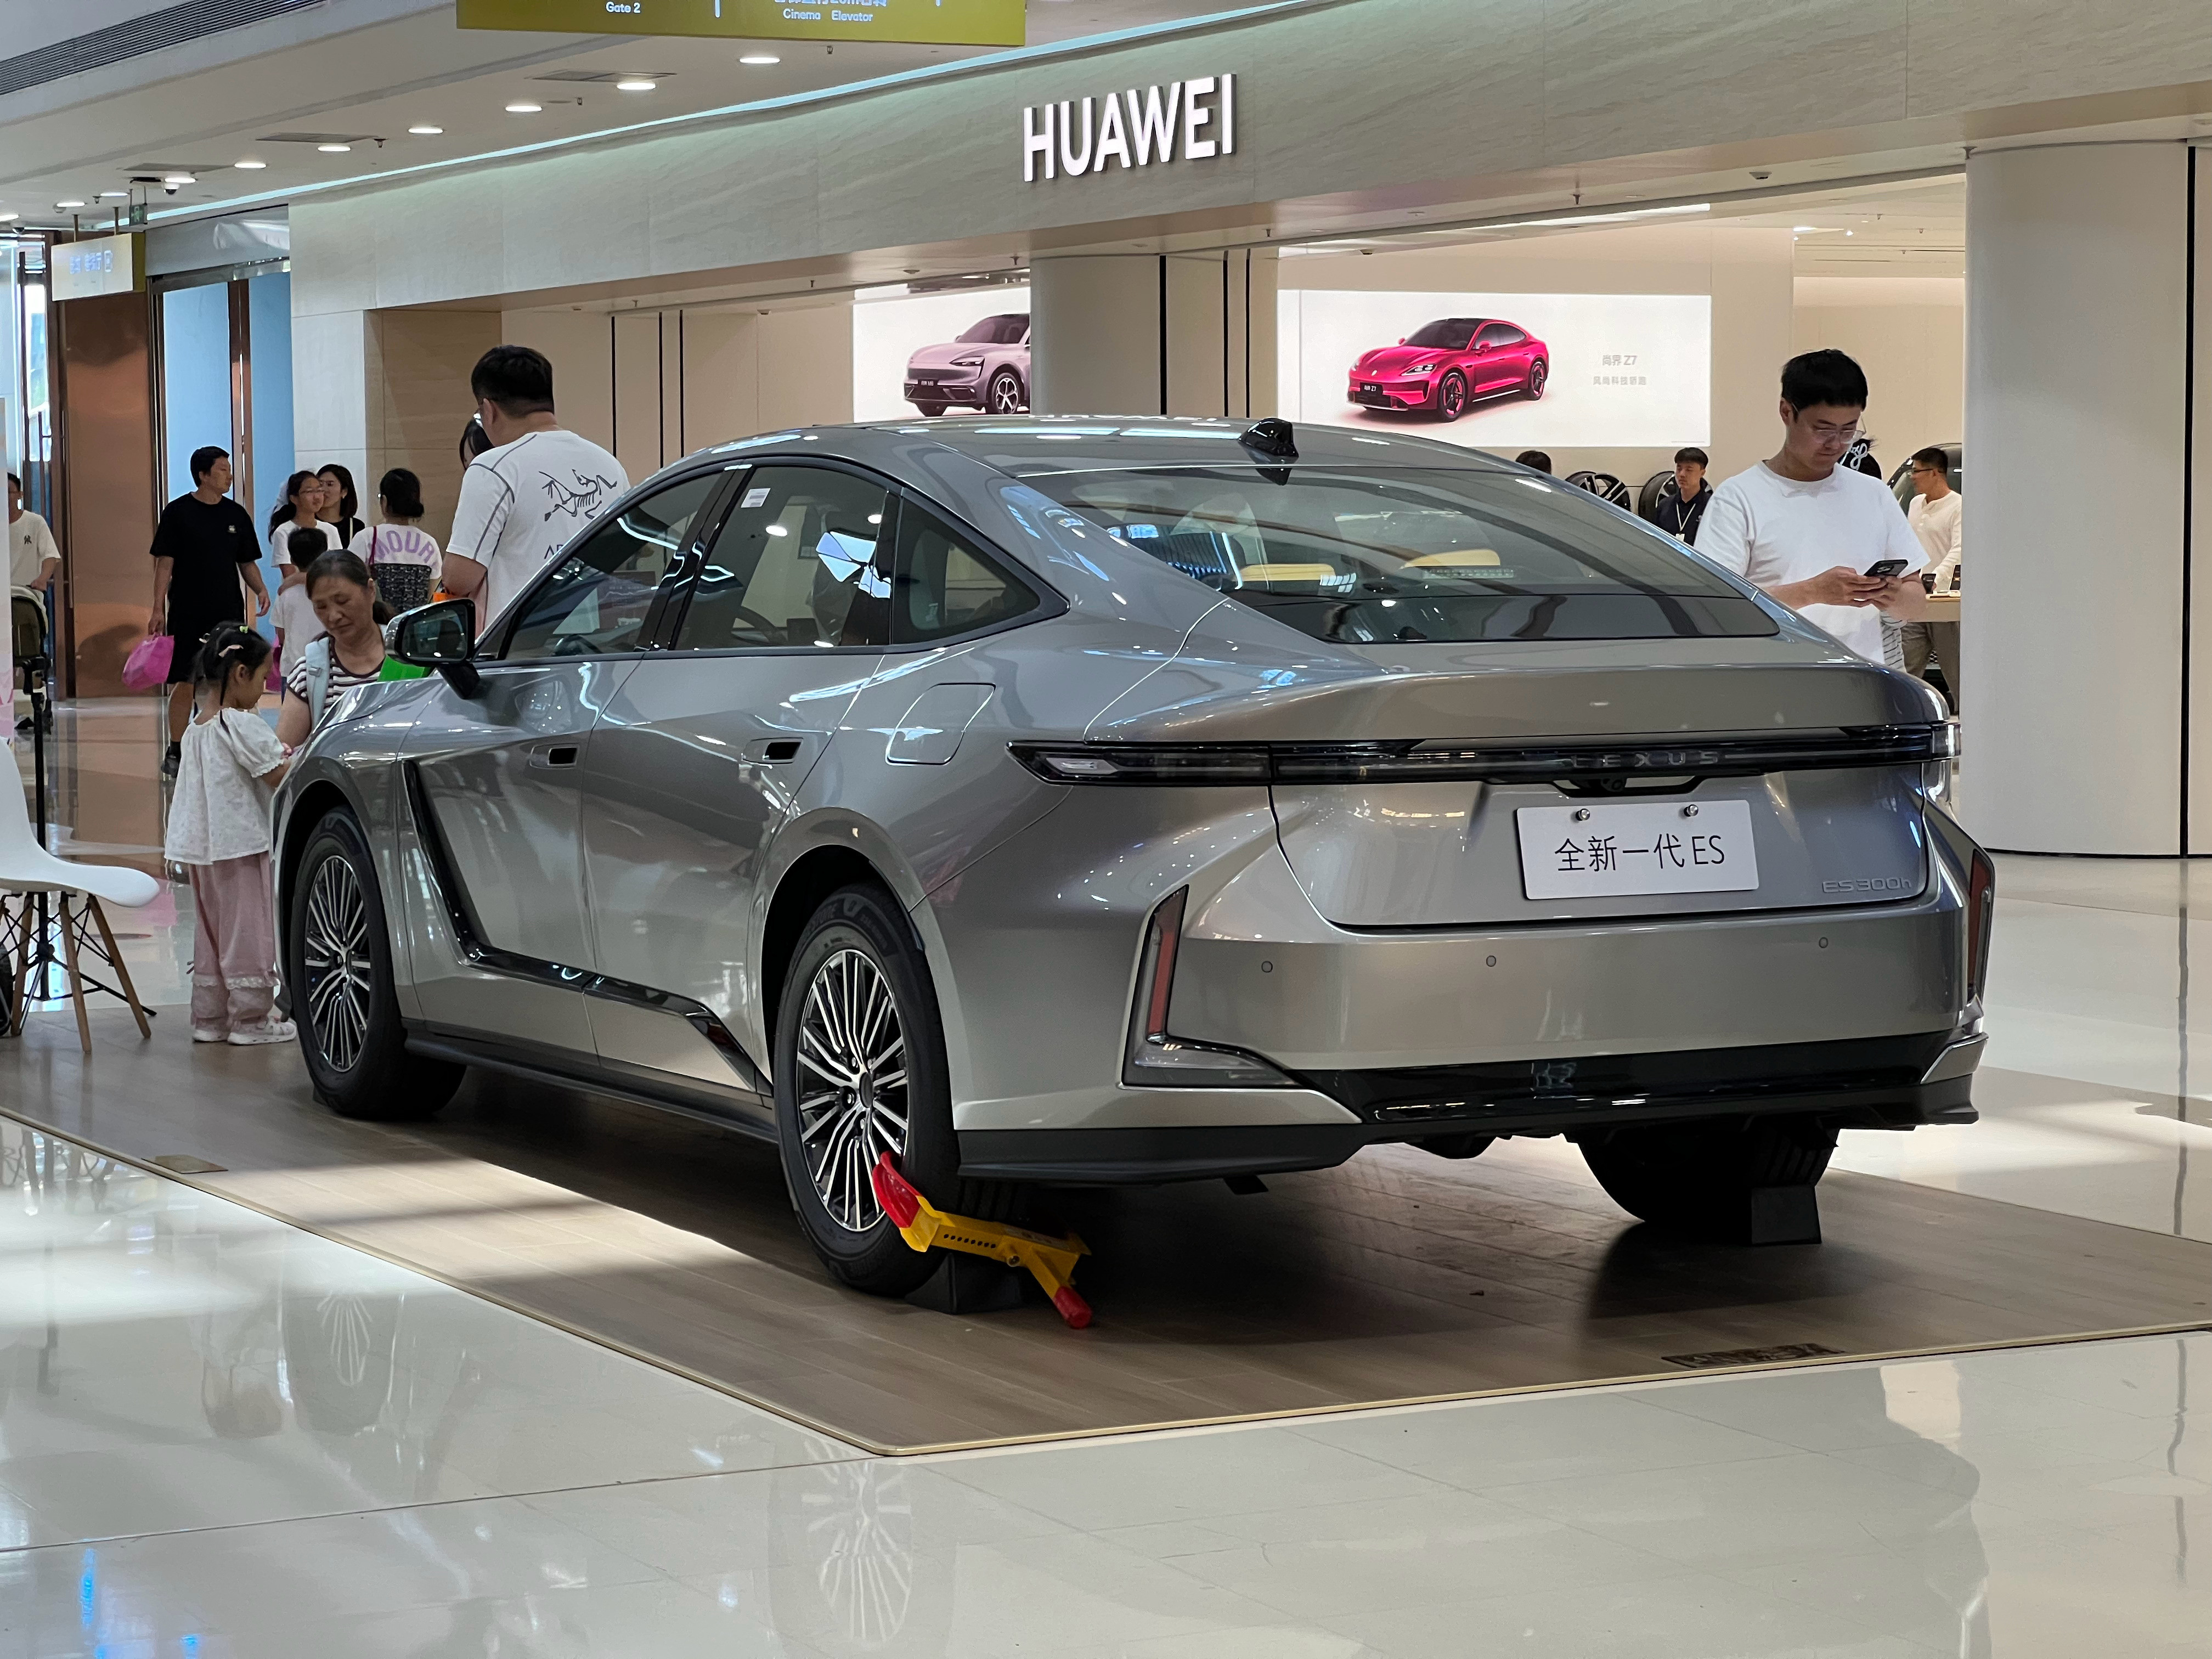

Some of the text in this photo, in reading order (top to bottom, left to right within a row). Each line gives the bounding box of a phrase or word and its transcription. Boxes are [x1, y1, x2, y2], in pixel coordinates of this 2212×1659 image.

[606, 2, 641, 13] Gate 2
[783, 8, 873, 21] Cinema Elevator
[1024, 73, 1235, 182] HUAWEI
[1623, 355, 1638, 365] Z7
[1571, 751, 1718, 768] LEXUS
[1554, 833, 1725, 872] 全新一代 ES
